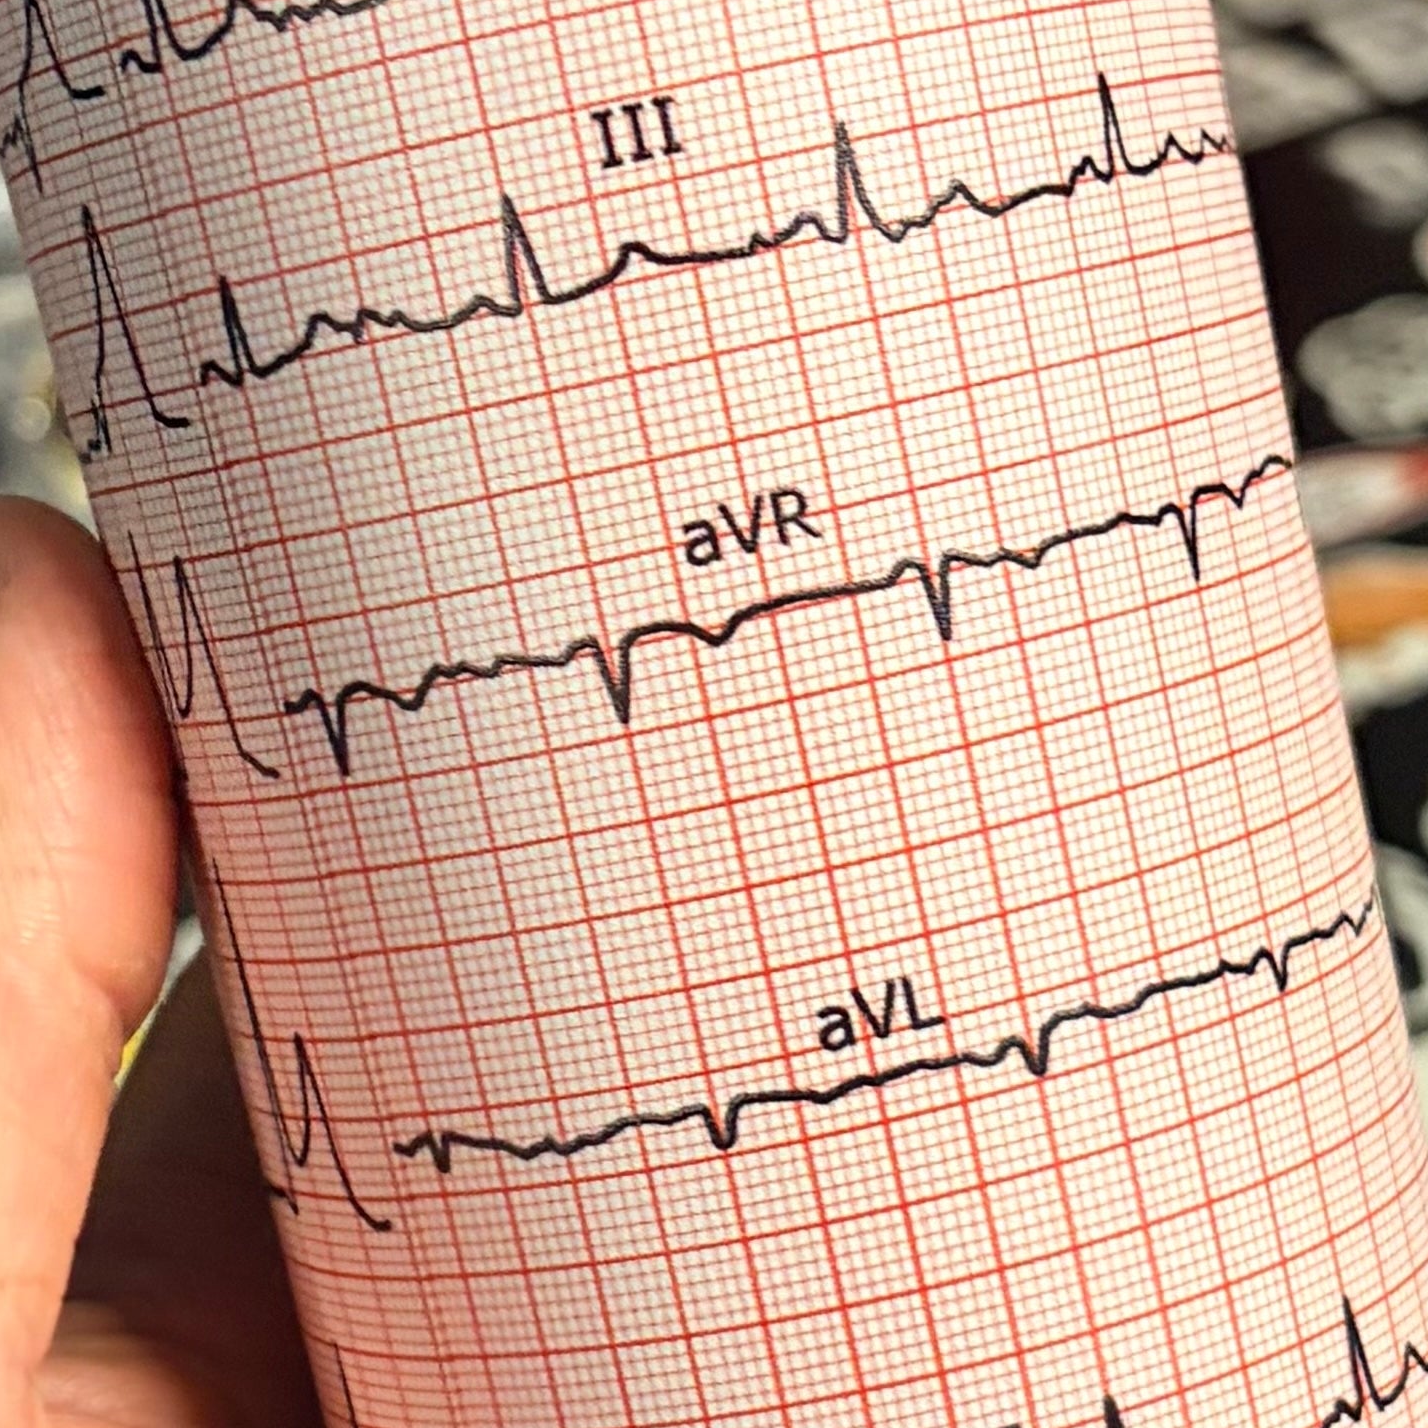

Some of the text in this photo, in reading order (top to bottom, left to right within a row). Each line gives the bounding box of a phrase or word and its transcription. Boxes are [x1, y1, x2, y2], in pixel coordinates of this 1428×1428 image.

[591, 96, 683, 169] III
[682, 490, 823, 566] aVR
[817, 977, 946, 1051] aVL
